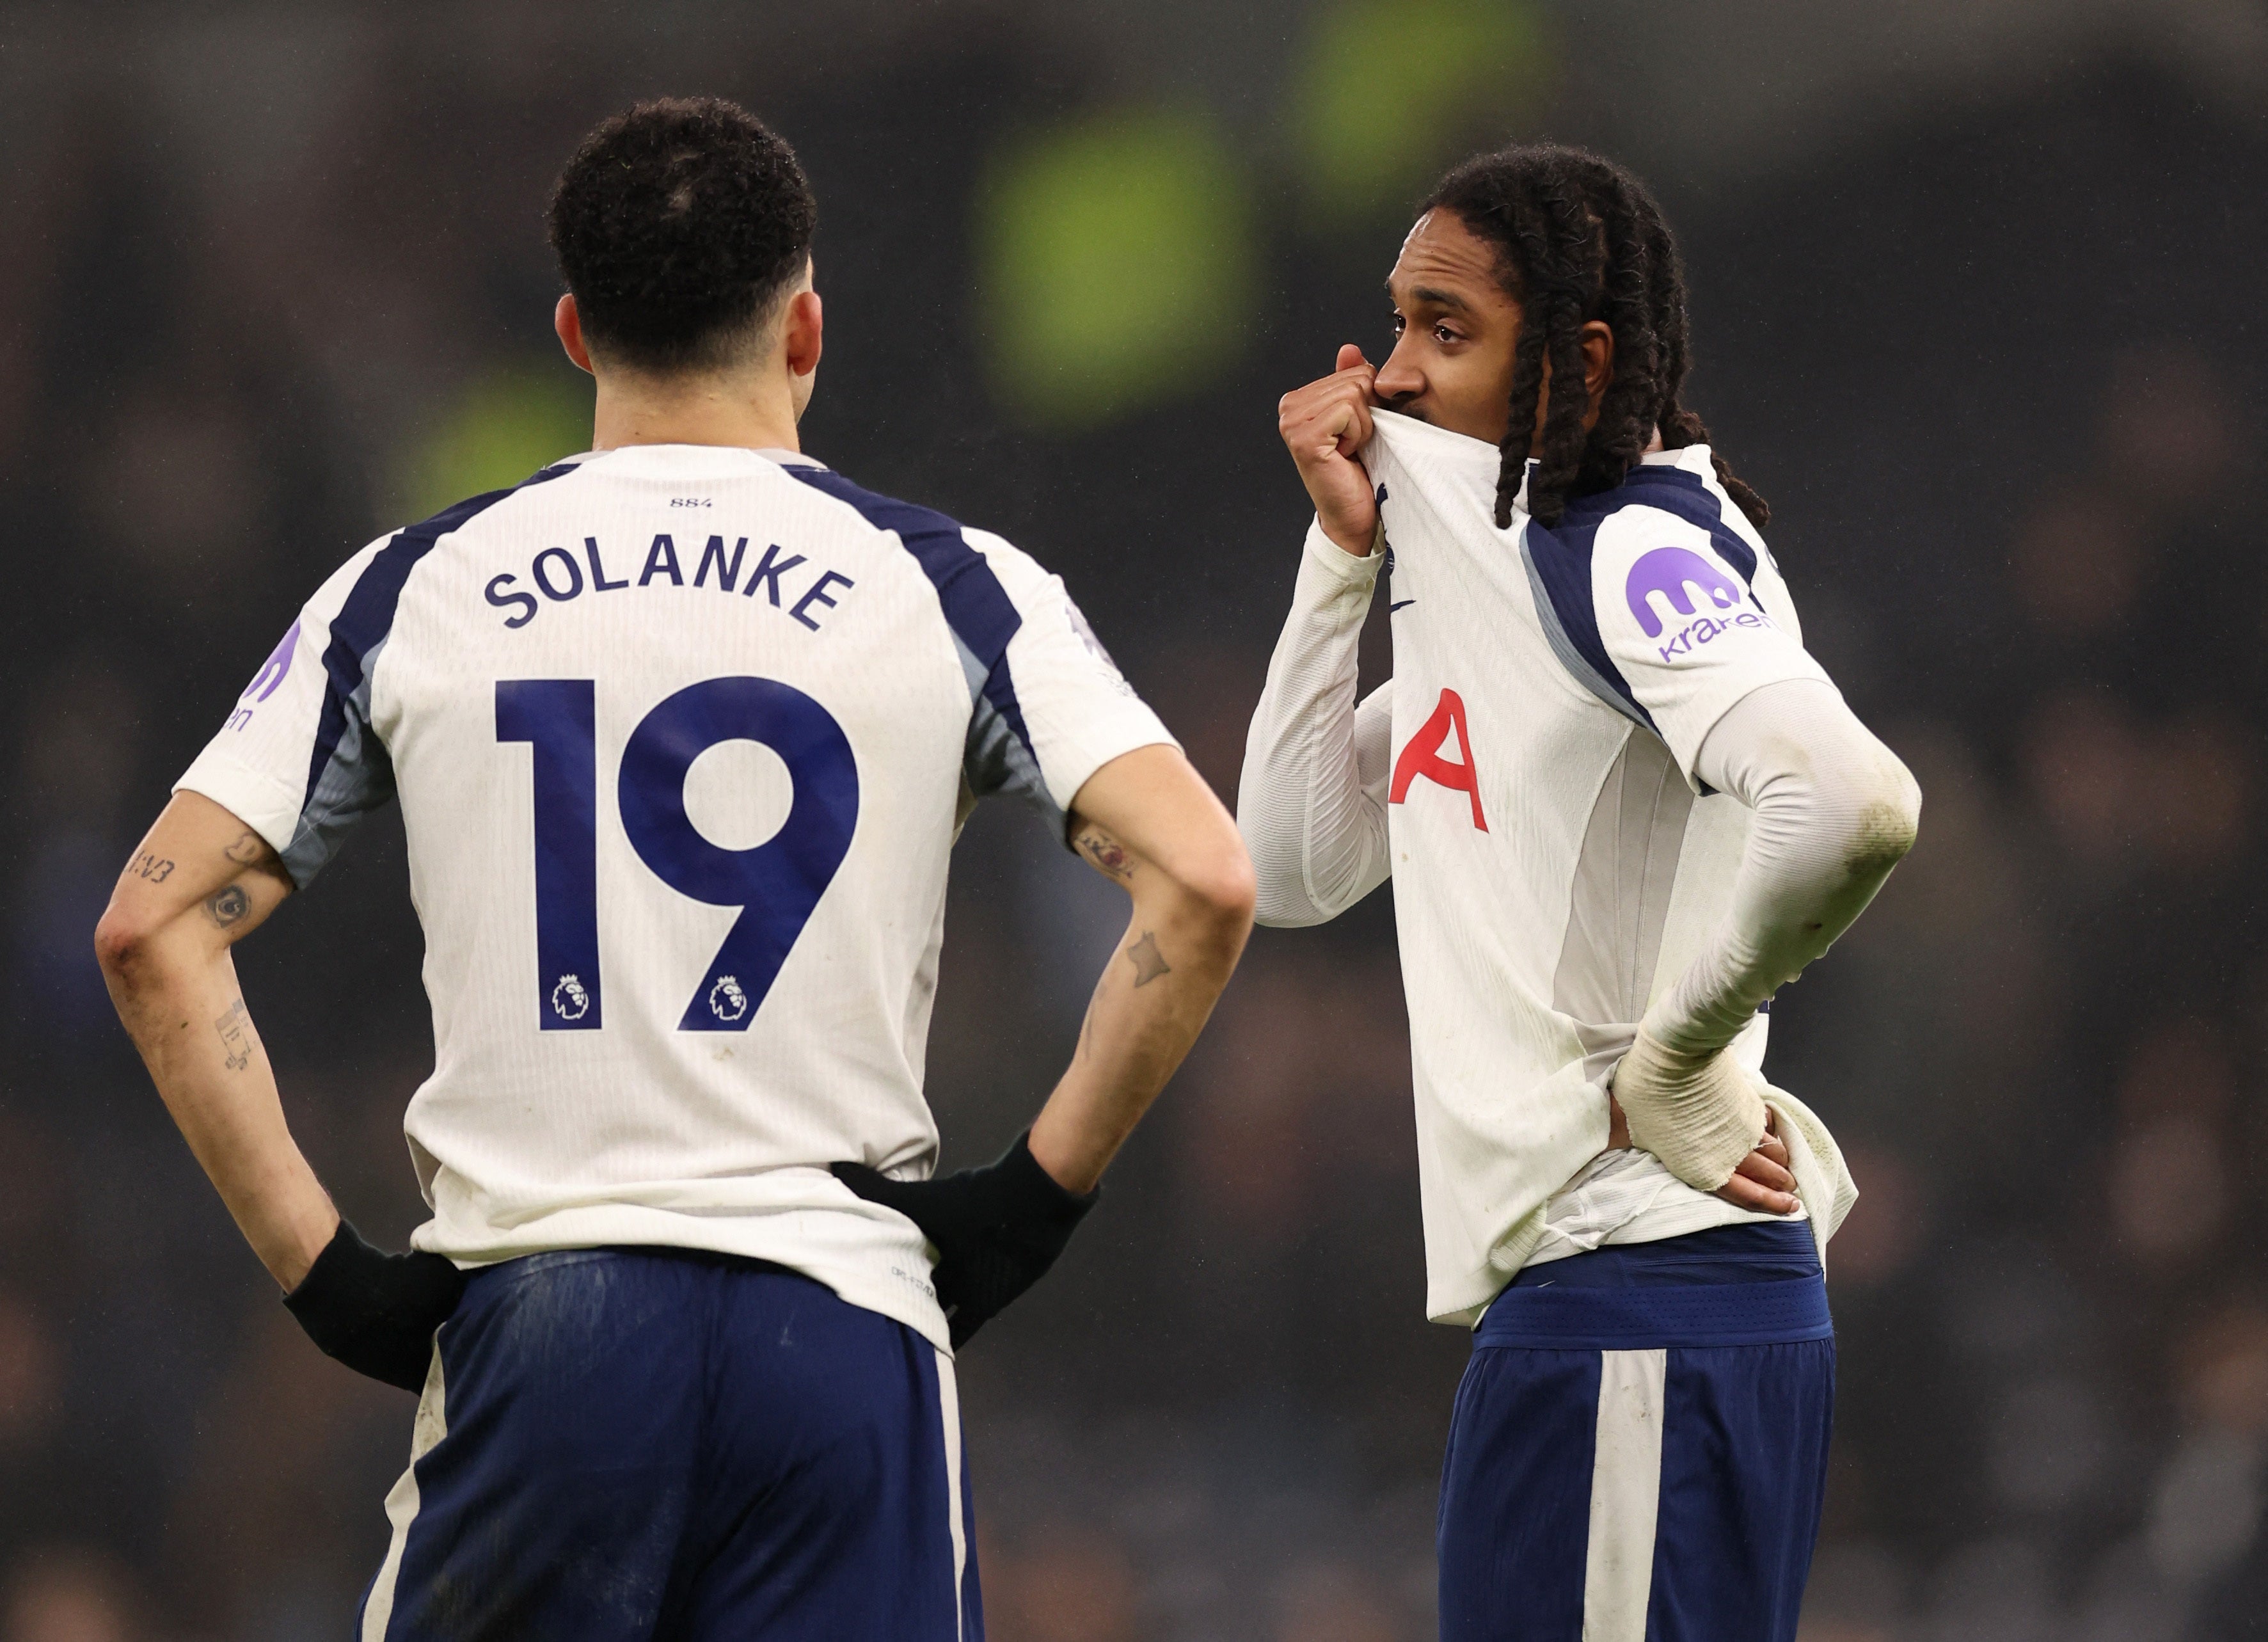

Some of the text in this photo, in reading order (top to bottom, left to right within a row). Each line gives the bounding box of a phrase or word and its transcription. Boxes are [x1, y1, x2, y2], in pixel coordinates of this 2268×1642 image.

[669, 498, 712, 508] 884
[484, 534, 856, 633] SOLANKE
[1388, 687, 1490, 834] A
[495, 675, 860, 1032] 19
